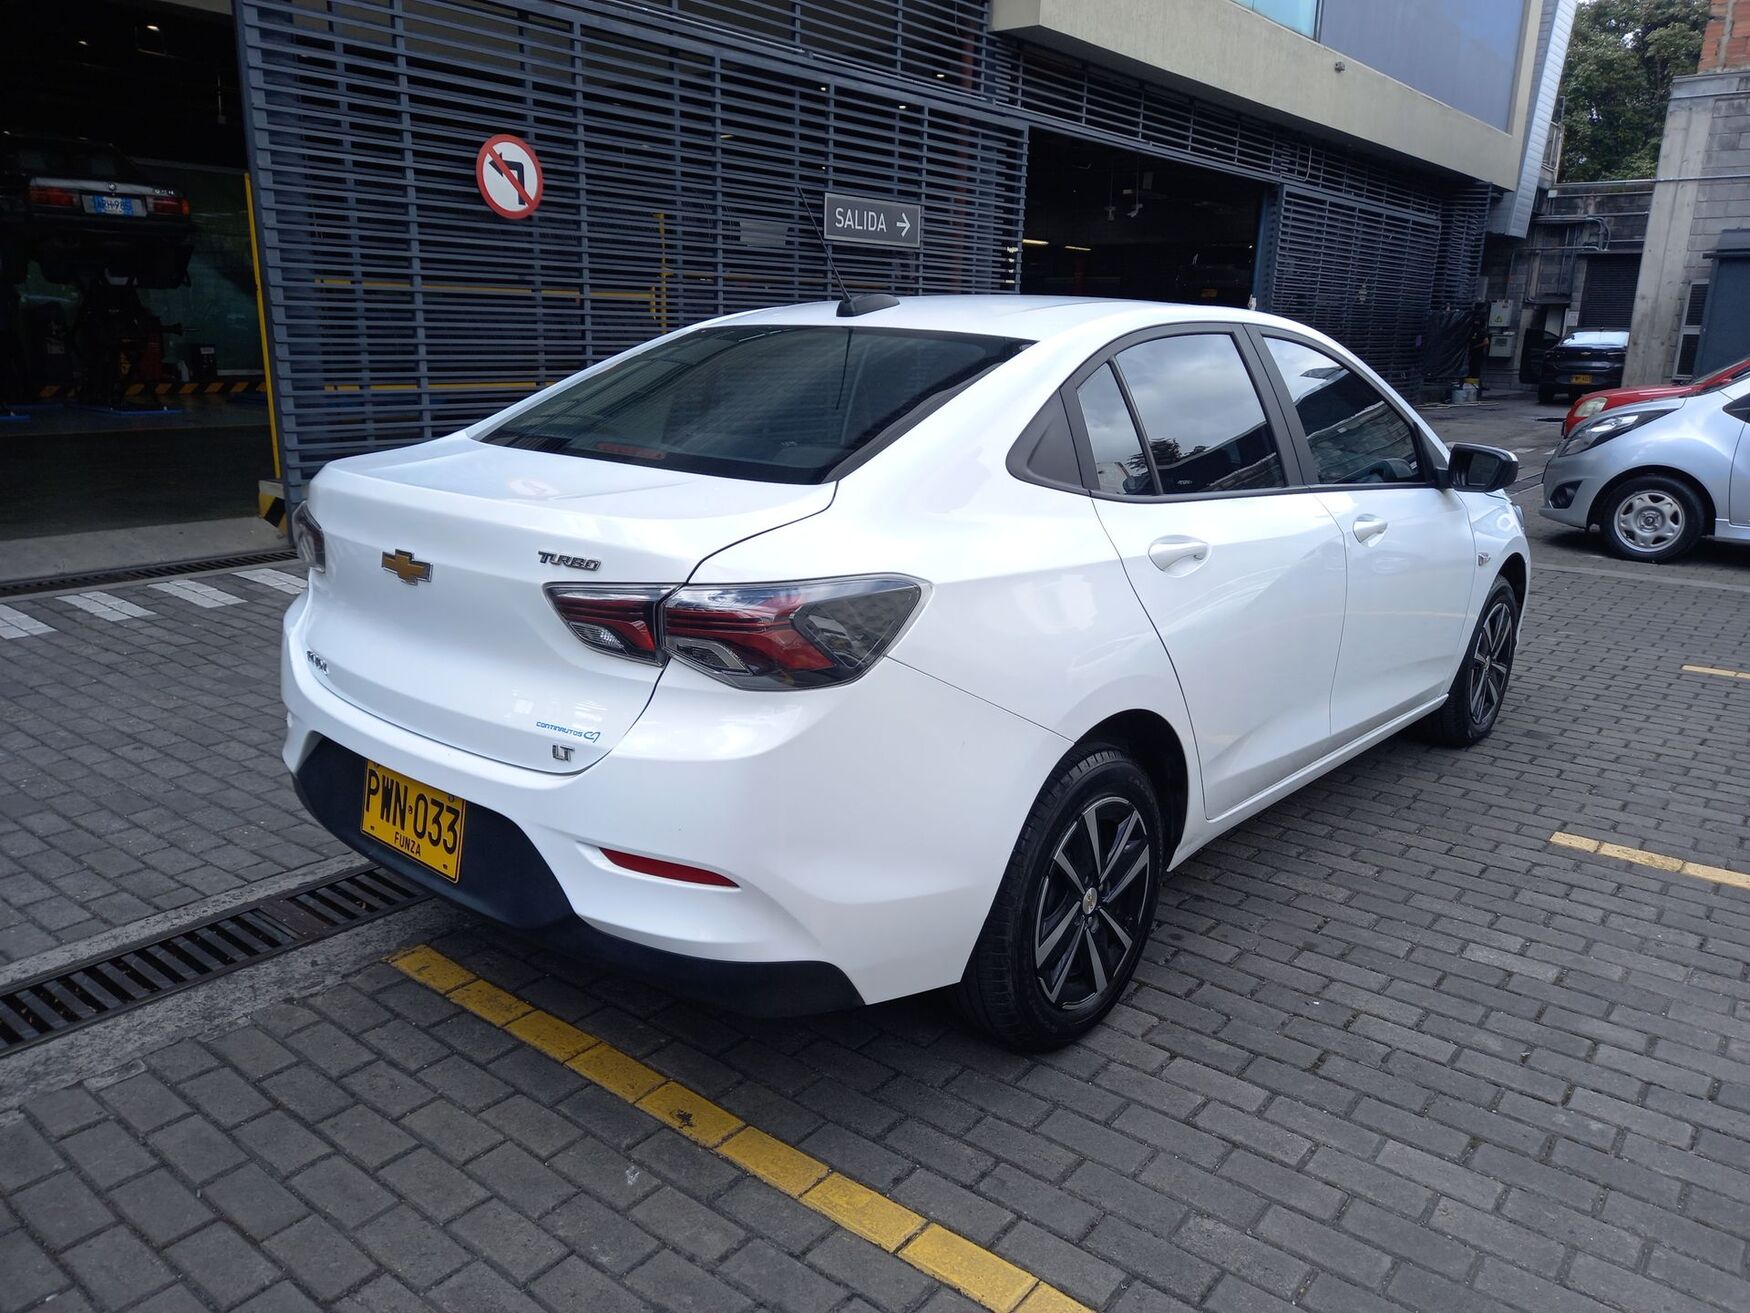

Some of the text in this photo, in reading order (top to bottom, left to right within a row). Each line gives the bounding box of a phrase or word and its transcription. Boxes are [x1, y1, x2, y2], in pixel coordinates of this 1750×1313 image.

[835, 207, 887, 232] SALIDA
[538, 550, 602, 571] TURBO
[552, 744, 575, 761] LT
[394, 831, 421, 857] FUNZA
